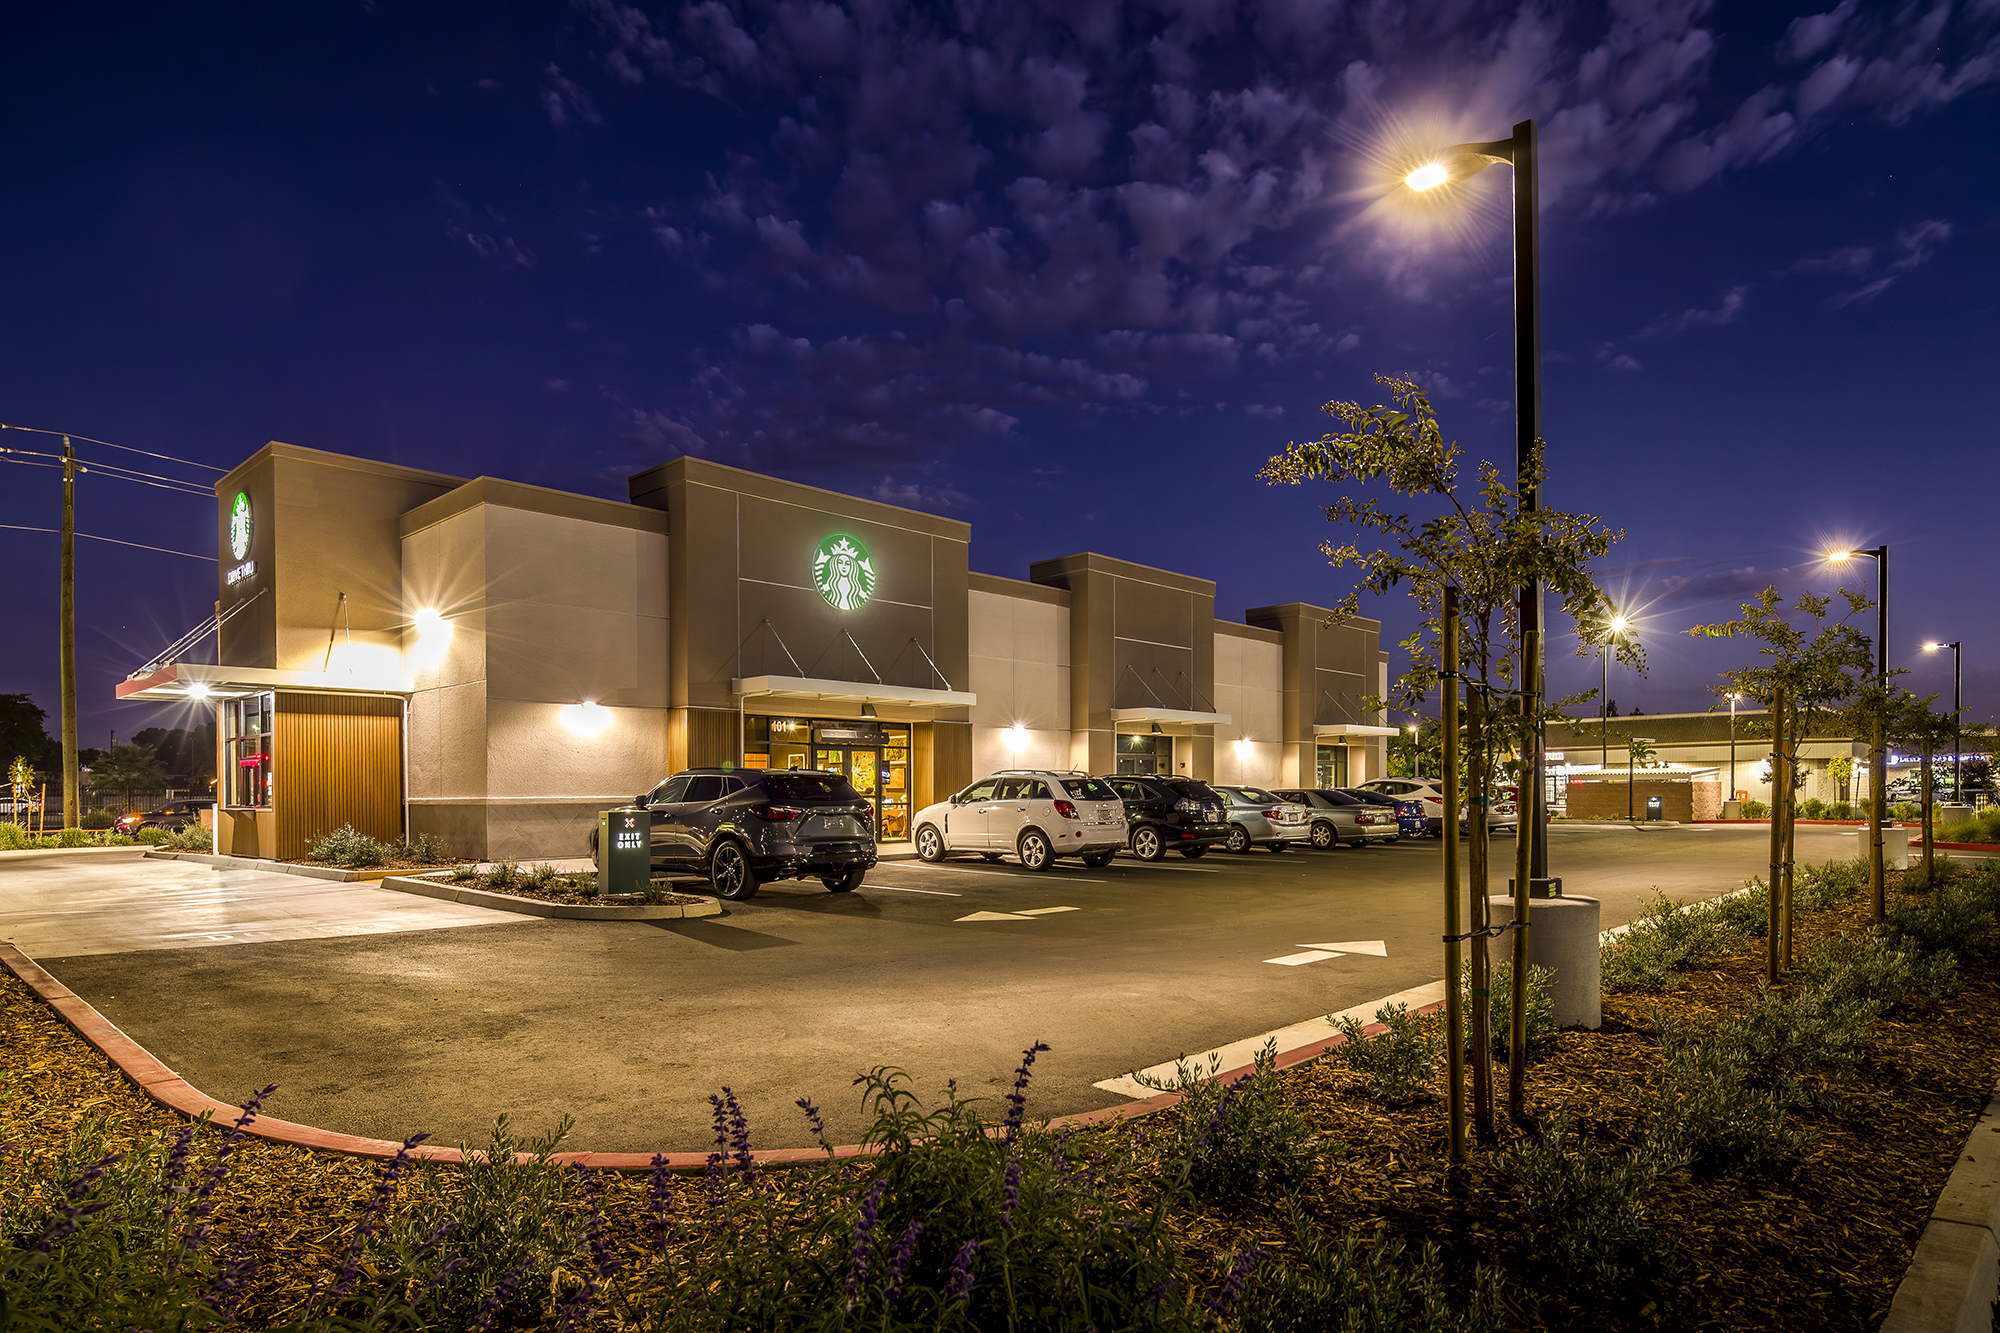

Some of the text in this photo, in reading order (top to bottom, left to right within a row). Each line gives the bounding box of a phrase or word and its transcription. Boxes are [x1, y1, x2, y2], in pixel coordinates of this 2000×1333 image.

[772, 720, 787, 733] 101
[618, 833, 641, 841] EXIT
[617, 841, 642, 849] ONLY
